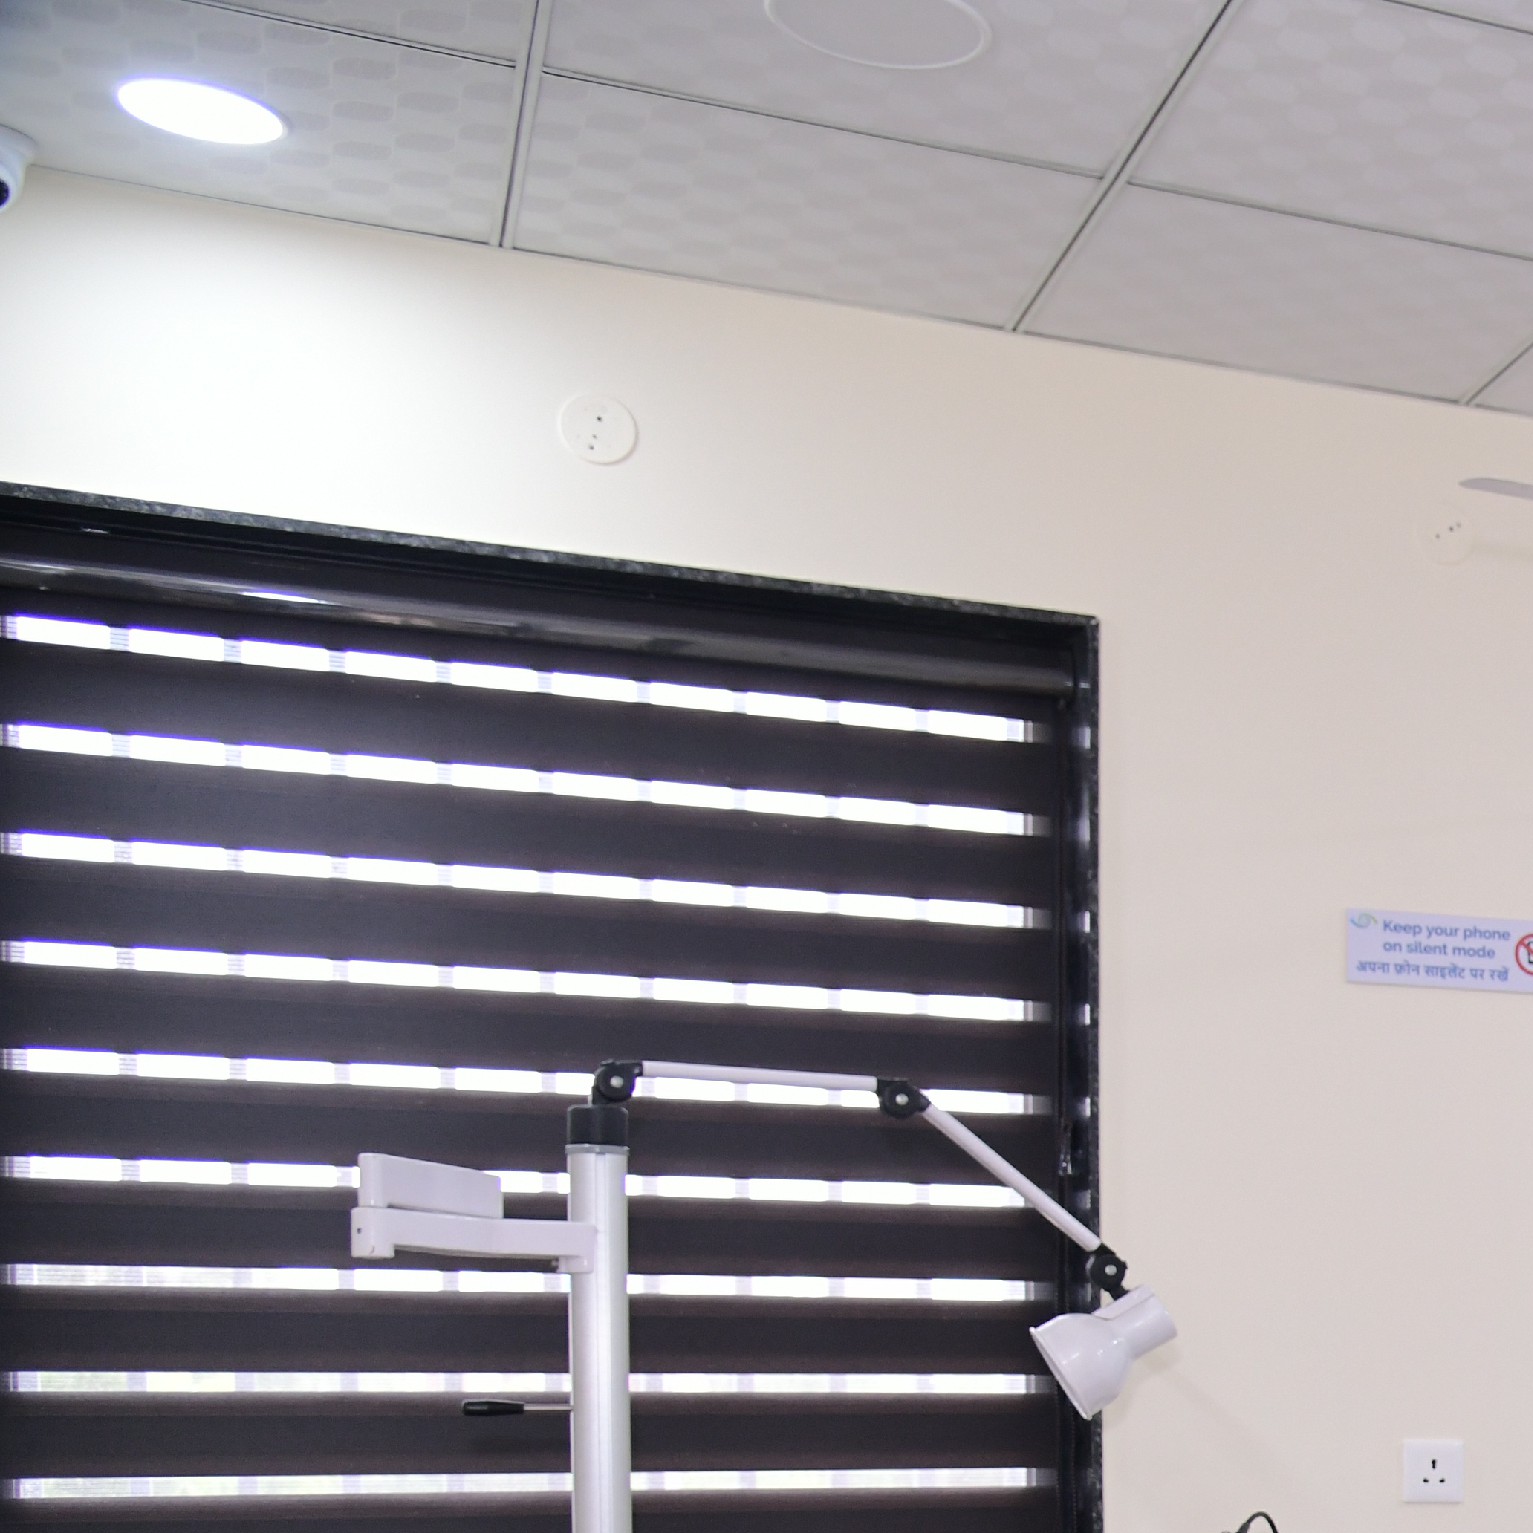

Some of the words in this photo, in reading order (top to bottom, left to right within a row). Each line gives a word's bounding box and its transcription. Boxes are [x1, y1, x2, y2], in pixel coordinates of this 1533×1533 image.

[1383, 920, 1423, 937] Keep
[1426, 925, 1460, 939] your
[1464, 926, 1511, 941] phone
[1383, 942, 1402, 952] on
[1407, 941, 1448, 956] silent
[1453, 945, 1497, 958] mode
